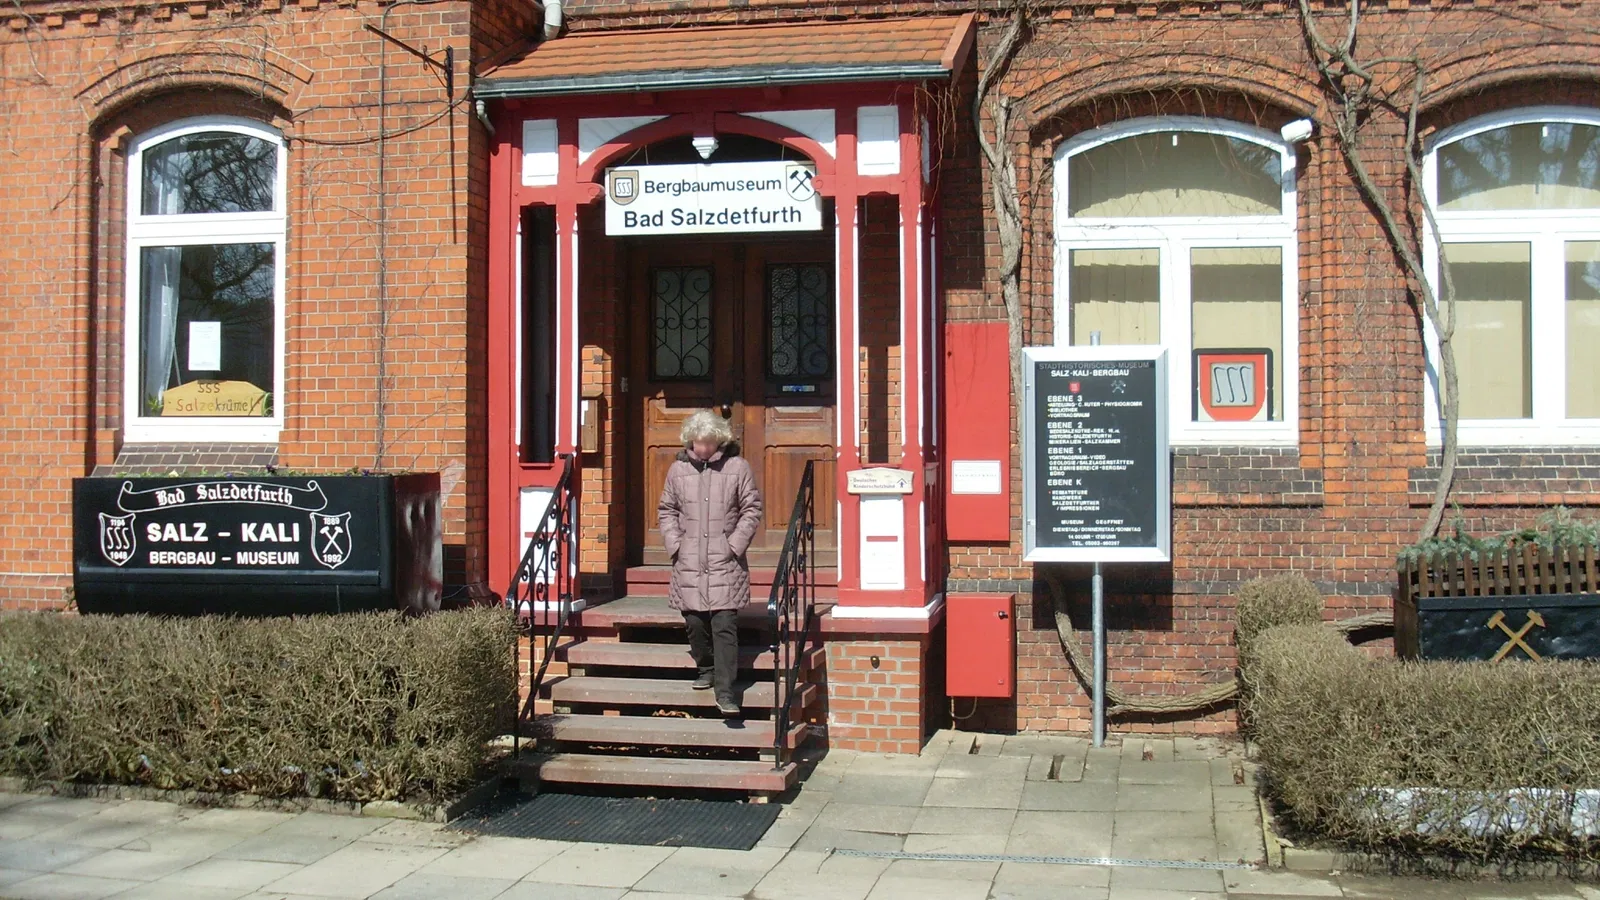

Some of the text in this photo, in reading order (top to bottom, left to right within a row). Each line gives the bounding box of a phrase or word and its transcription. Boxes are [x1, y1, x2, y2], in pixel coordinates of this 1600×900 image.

[644, 179, 782, 197] Bergbaumuseum
[624, 206, 802, 228] Bad Salzdetfurth
[197, 382, 221, 394] SSS
[1047, 395, 1074, 403] EBENE
[155, 484, 293, 507] Bad Salzdetfurth
[146, 522, 209, 542] SALZ
[241, 522, 300, 542] KALI
[149, 551, 216, 565] BERGBAU
[237, 551, 300, 565] MUSEUM
[323, 554, 343, 563] 1992
